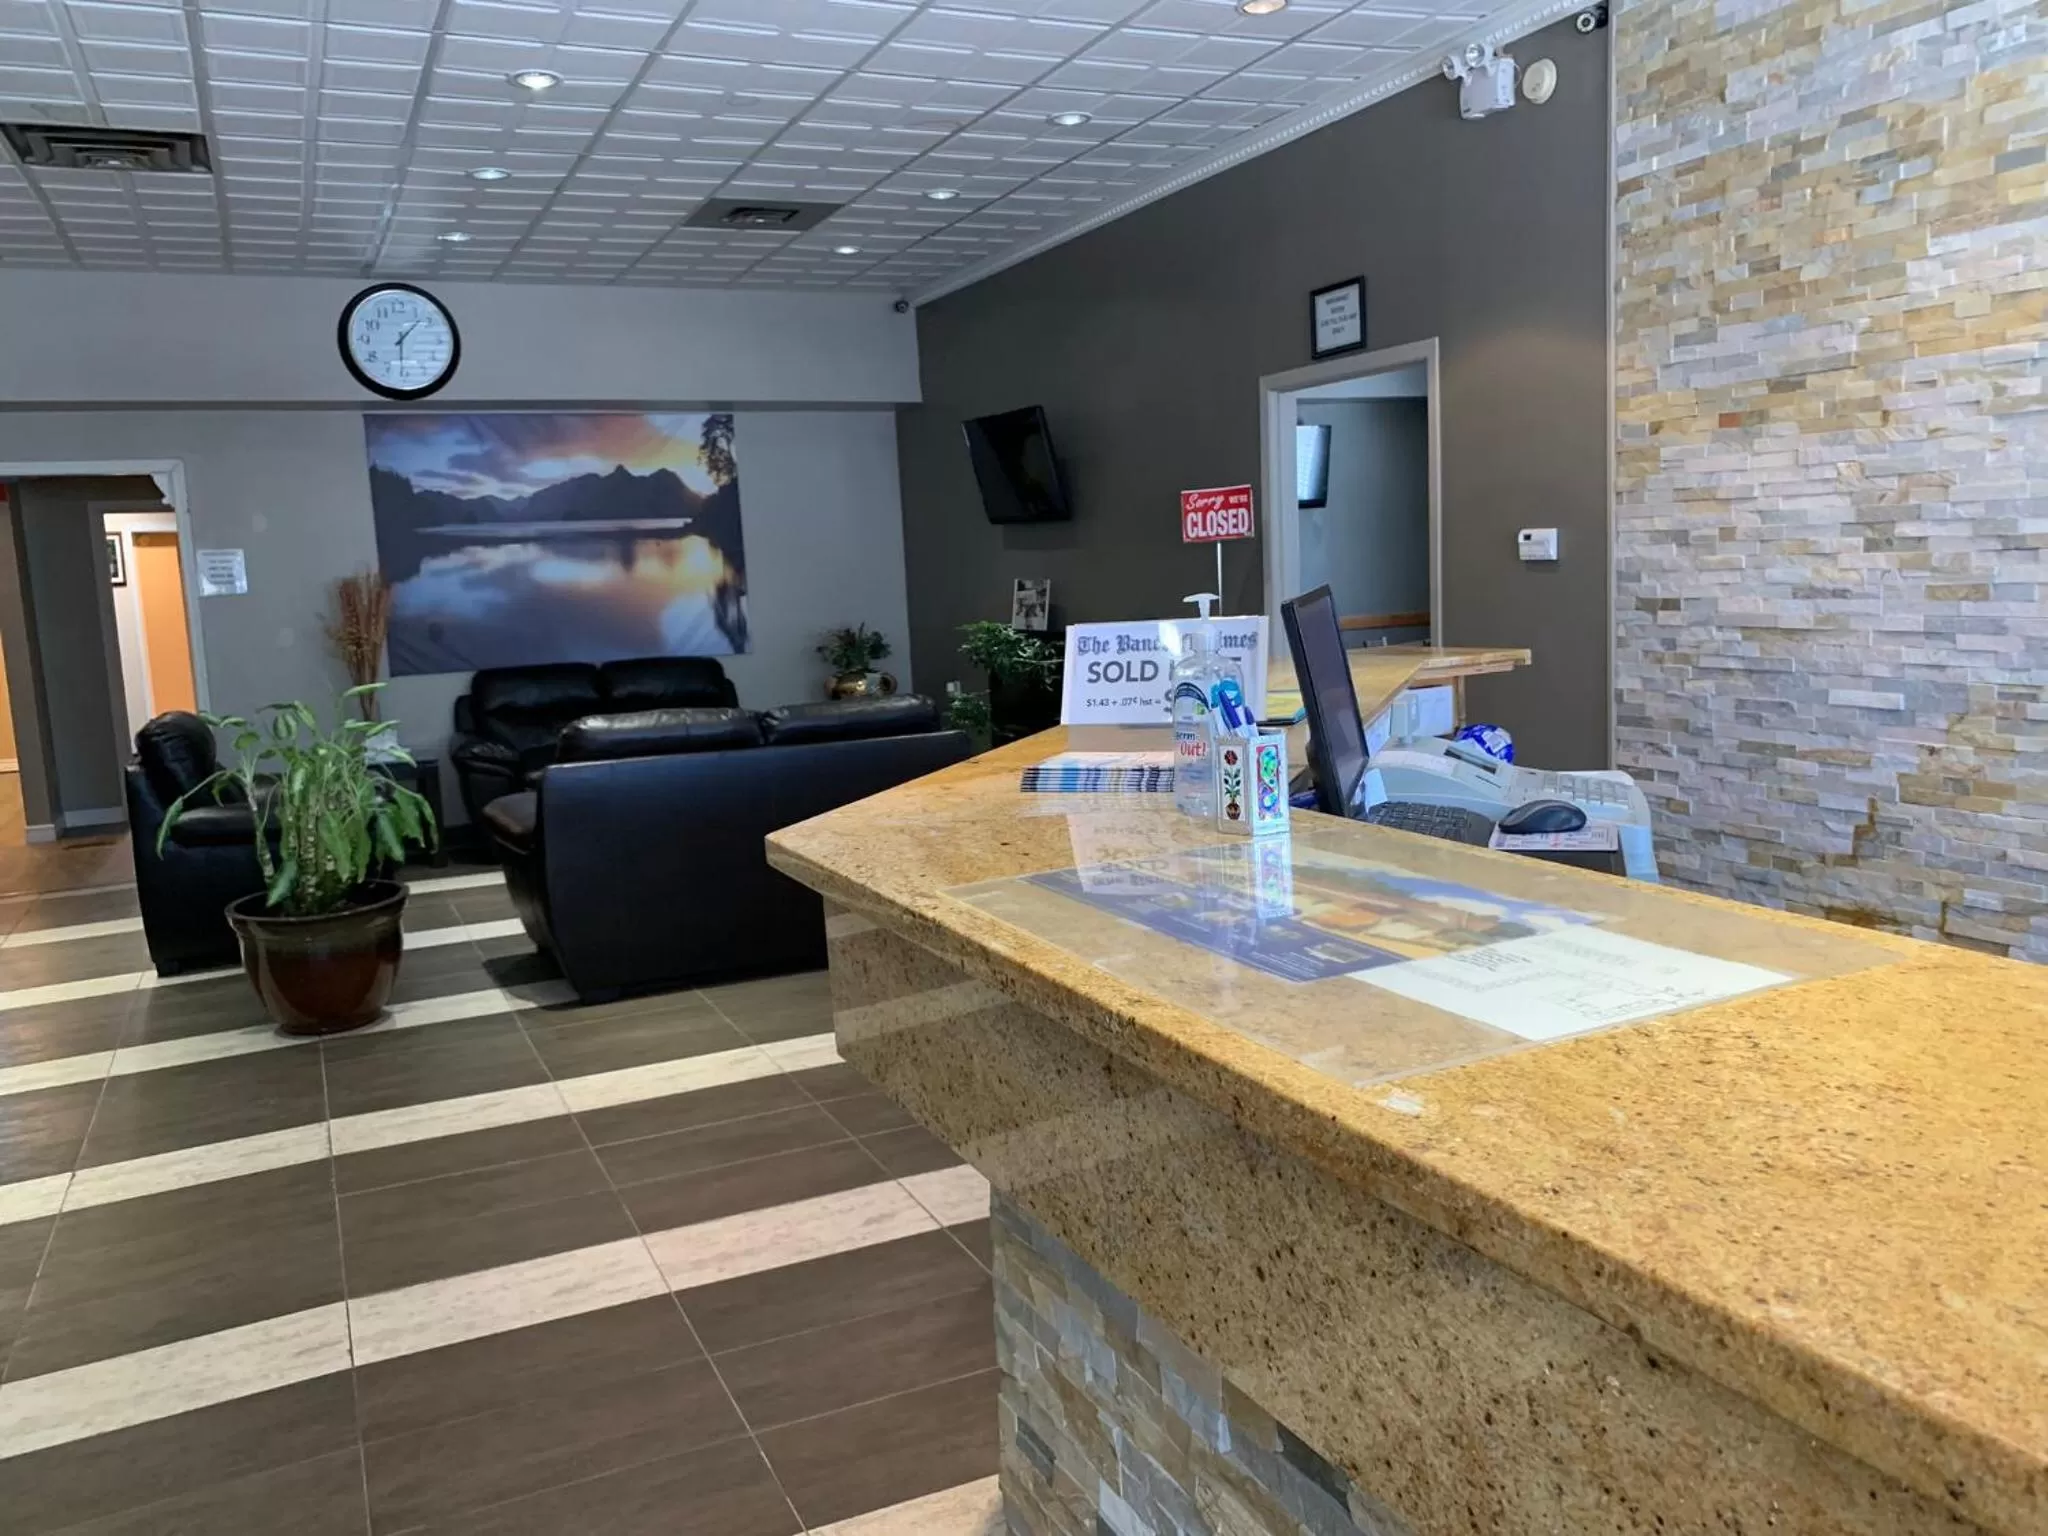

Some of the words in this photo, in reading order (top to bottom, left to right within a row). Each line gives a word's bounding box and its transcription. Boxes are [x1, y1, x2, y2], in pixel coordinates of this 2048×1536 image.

[377, 306, 388, 319] 11
[392, 299, 406, 314] 12
[365, 319, 380, 331] 10
[1185, 493, 1225, 510] Sorry
[1187, 508, 1249, 538] CLOSED
[1077, 635, 1110, 656] The
[1217, 629, 1258, 652] imes
[1087, 660, 1159, 683] SOLD
[1086, 698, 1110, 708] $1.43
[1139, 697, 1152, 706] hst
[1180, 741, 1207, 757] Out!
